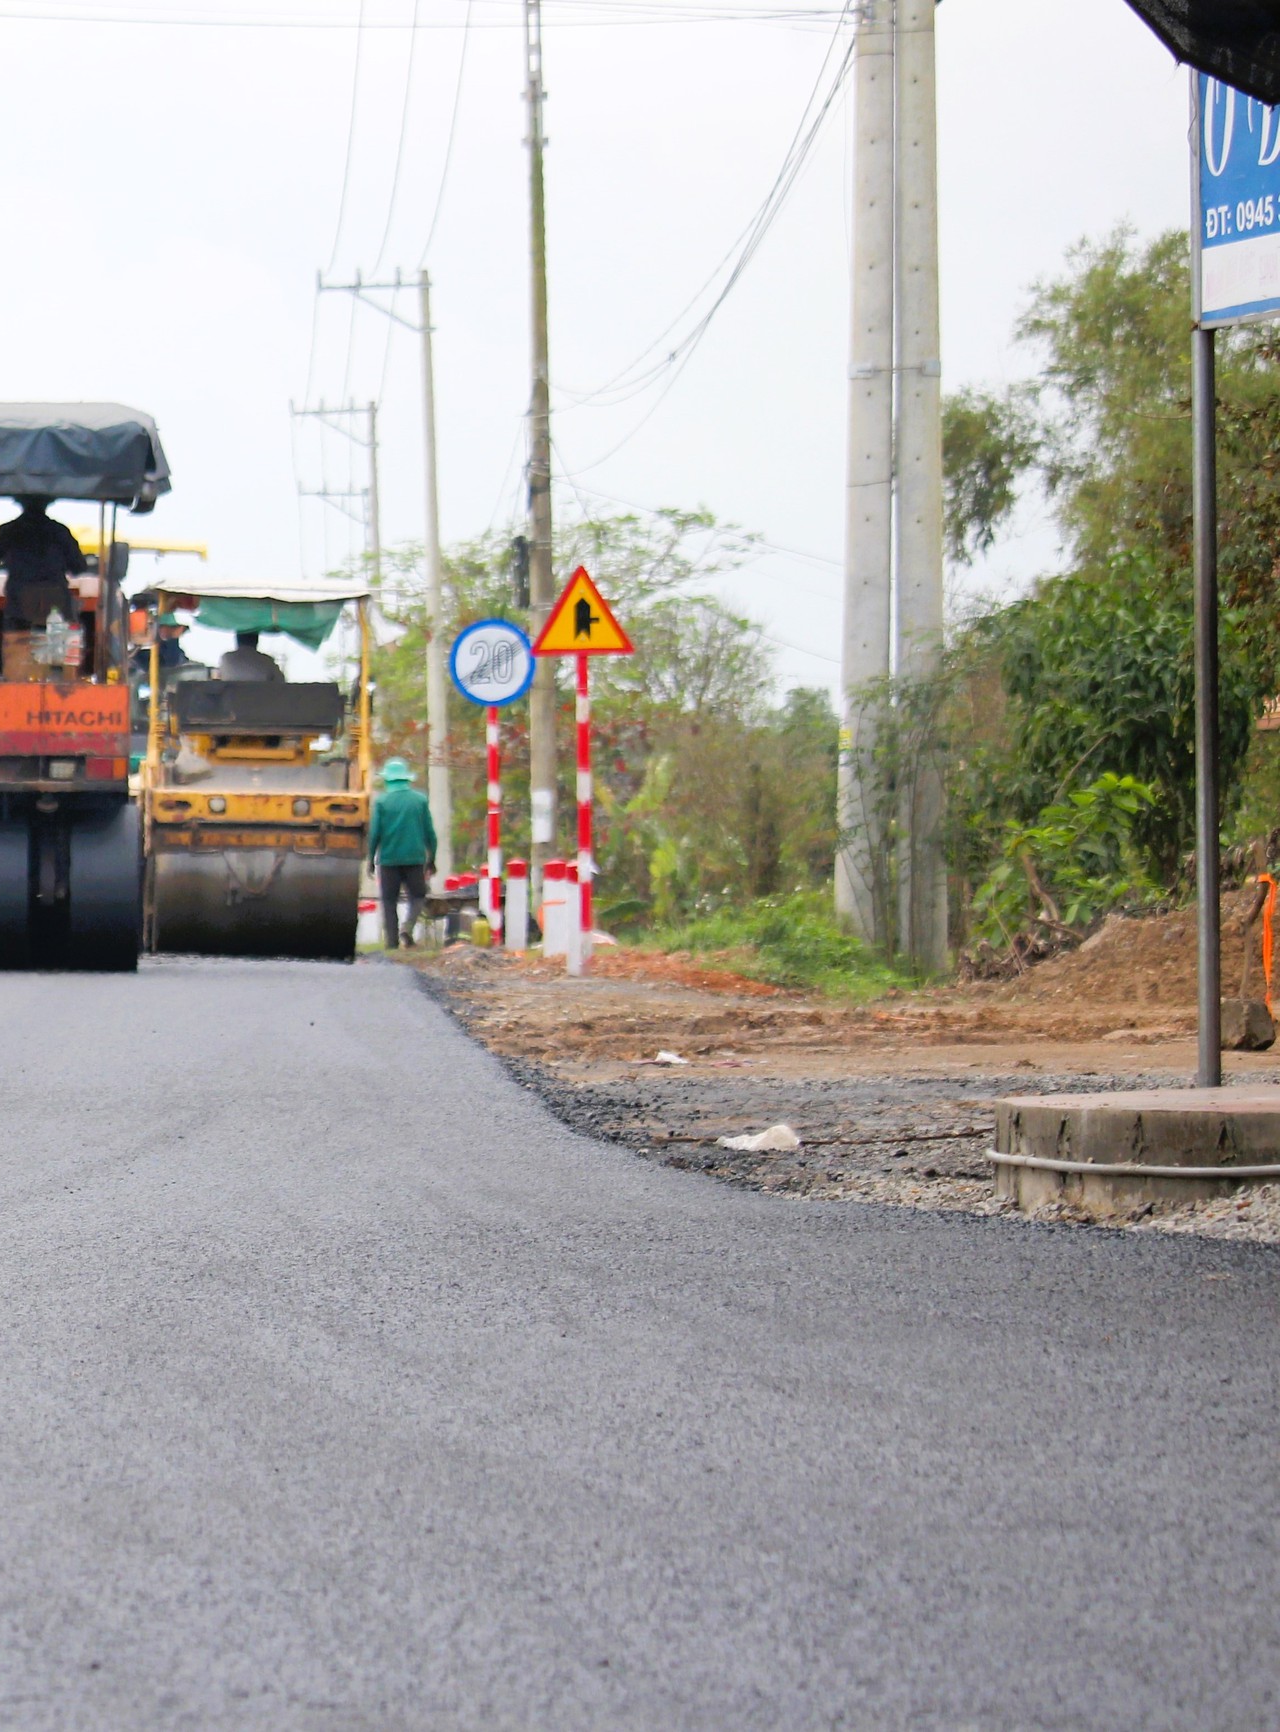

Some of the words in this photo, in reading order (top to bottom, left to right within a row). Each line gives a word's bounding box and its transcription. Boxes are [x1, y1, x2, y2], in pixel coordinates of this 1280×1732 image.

[1205, 205, 1231, 239] ĐT:
[1235, 195, 1274, 232] 0945
[470, 640, 514, 685] 20
[26, 711, 122, 726] HITACHI
